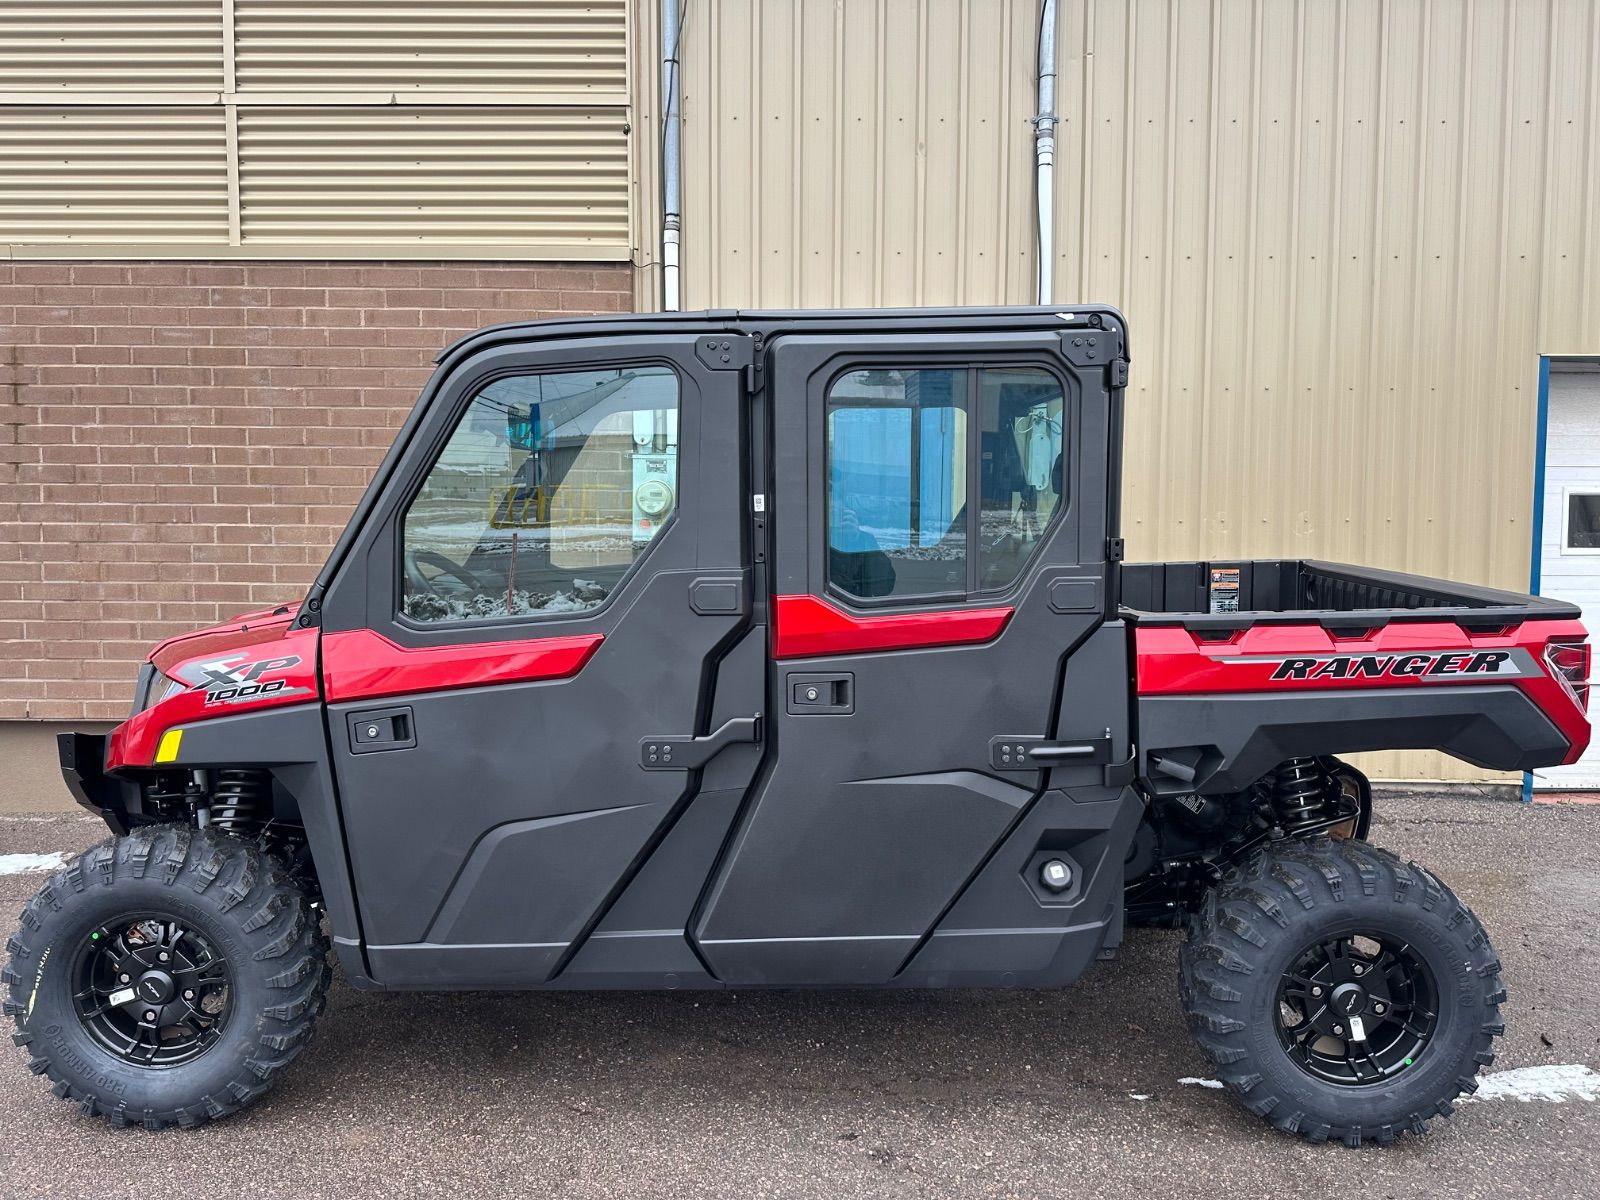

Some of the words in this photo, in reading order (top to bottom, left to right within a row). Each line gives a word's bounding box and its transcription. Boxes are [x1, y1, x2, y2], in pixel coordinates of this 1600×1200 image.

[190, 655, 303, 691] XP
[1270, 651, 1511, 681] RANGER
[204, 679, 286, 703] 1000
[51, 1036, 98, 1081] ARMOR
[95, 1074, 127, 1097] PRO
